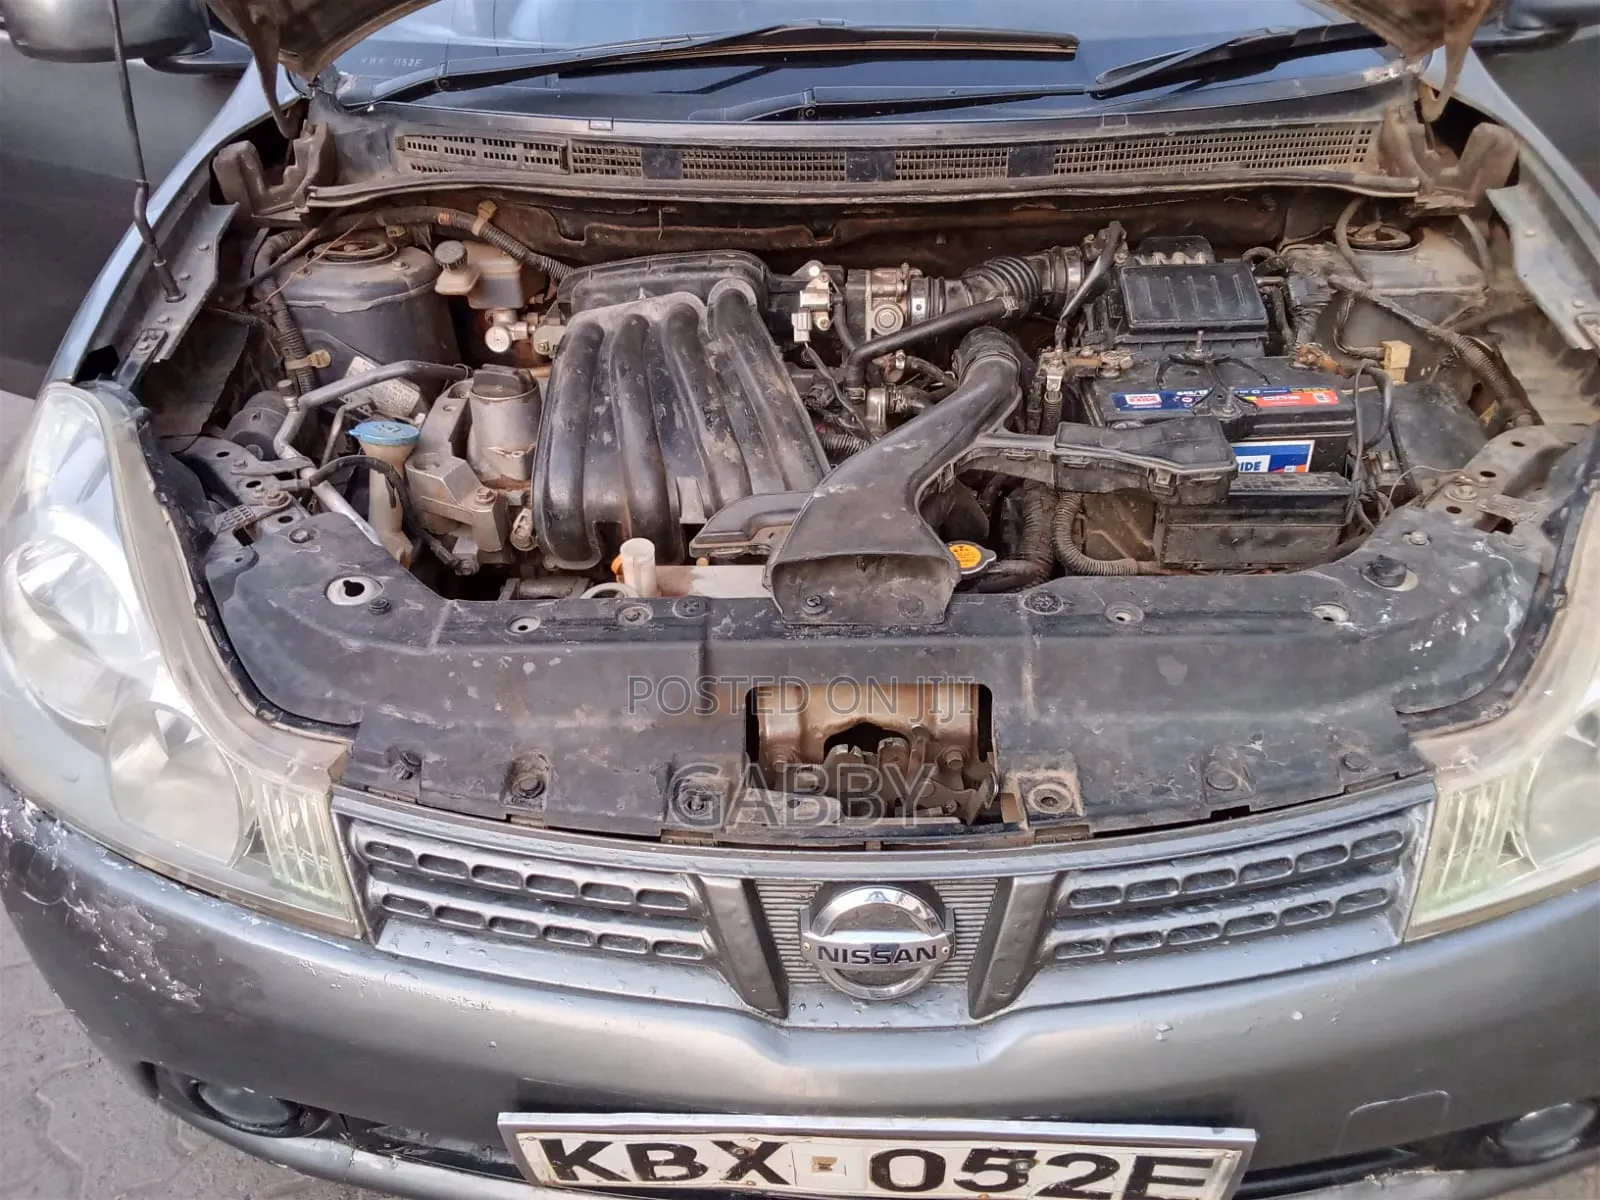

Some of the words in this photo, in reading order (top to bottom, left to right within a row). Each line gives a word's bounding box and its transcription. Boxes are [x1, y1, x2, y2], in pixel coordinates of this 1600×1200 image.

[393, 56, 423, 67] 052E
[817, 944, 937, 965] NISSAN
[537, 1138, 790, 1186] KBX
[869, 1147, 1215, 1200] 052E
